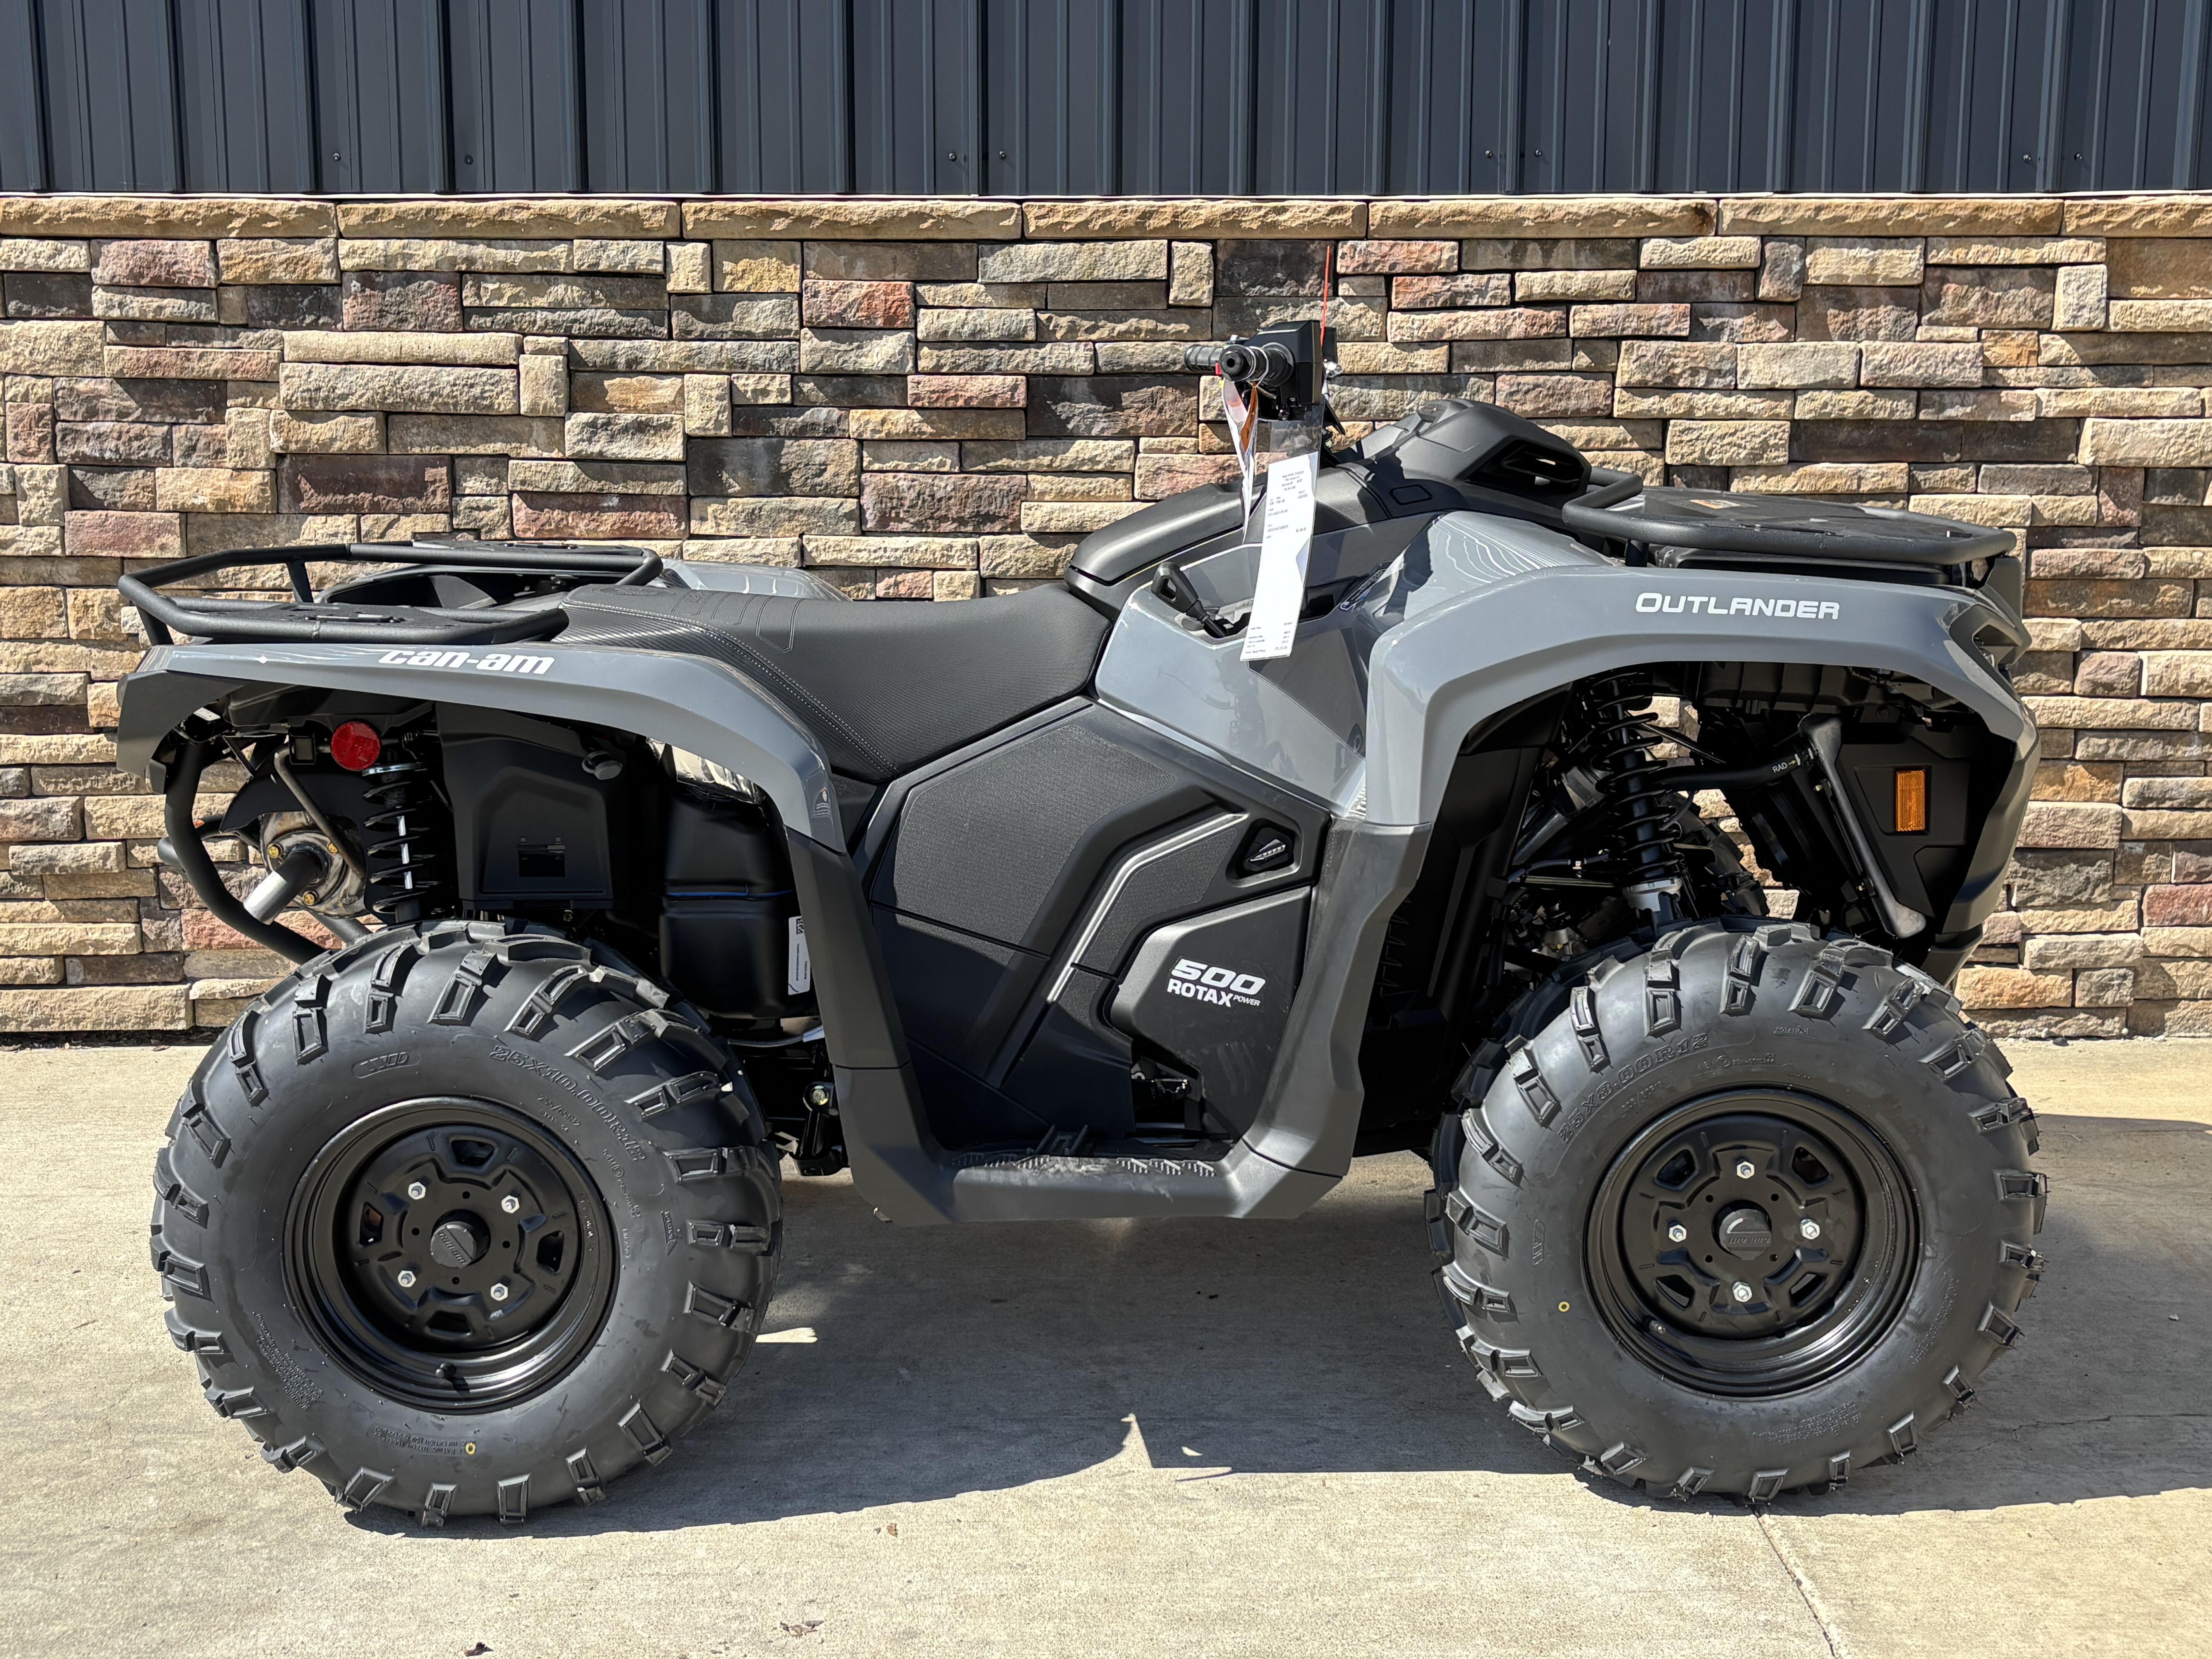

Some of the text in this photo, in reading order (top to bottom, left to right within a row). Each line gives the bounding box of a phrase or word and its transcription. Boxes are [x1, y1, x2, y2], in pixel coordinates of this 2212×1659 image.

[1635, 592, 1840, 620] OUTLANDER
[378, 650, 555, 675] can-am
[1772, 762, 1788, 773] RAD
[1171, 958, 1266, 996] 500
[1167, 978, 1261, 1008] ROTAX POWER
